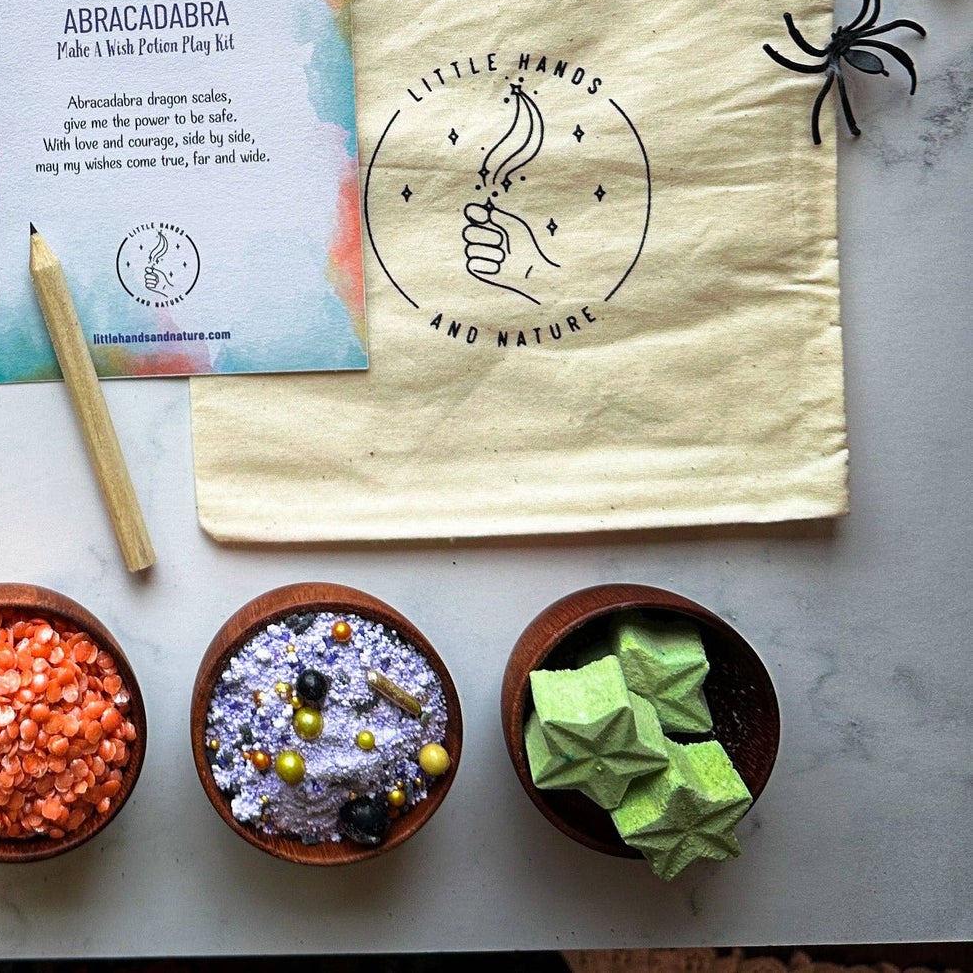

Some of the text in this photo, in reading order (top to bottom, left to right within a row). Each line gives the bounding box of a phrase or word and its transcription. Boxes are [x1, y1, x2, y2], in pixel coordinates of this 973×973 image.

[63, 0, 230, 35] ABRACADABRA
[56, 33, 234, 60] Make A Wish Potion Play Kit
[406, 52, 602, 102] LITTLE HANDS
[67, 88, 231, 109] Abracadabra dragon scales,
[63, 107, 236, 134] give me the power to be safe.
[42, 128, 254, 151] With love and courage, side by side,
[35, 148, 269, 176] may my wishes come true, far and wide.
[128, 222, 184, 238] LITTLE HANDS
[136, 295, 184, 307] AND NATURE
[93, 330, 230, 344] littlehandsandnature.com
[429, 305, 596, 347] AND NATURE
